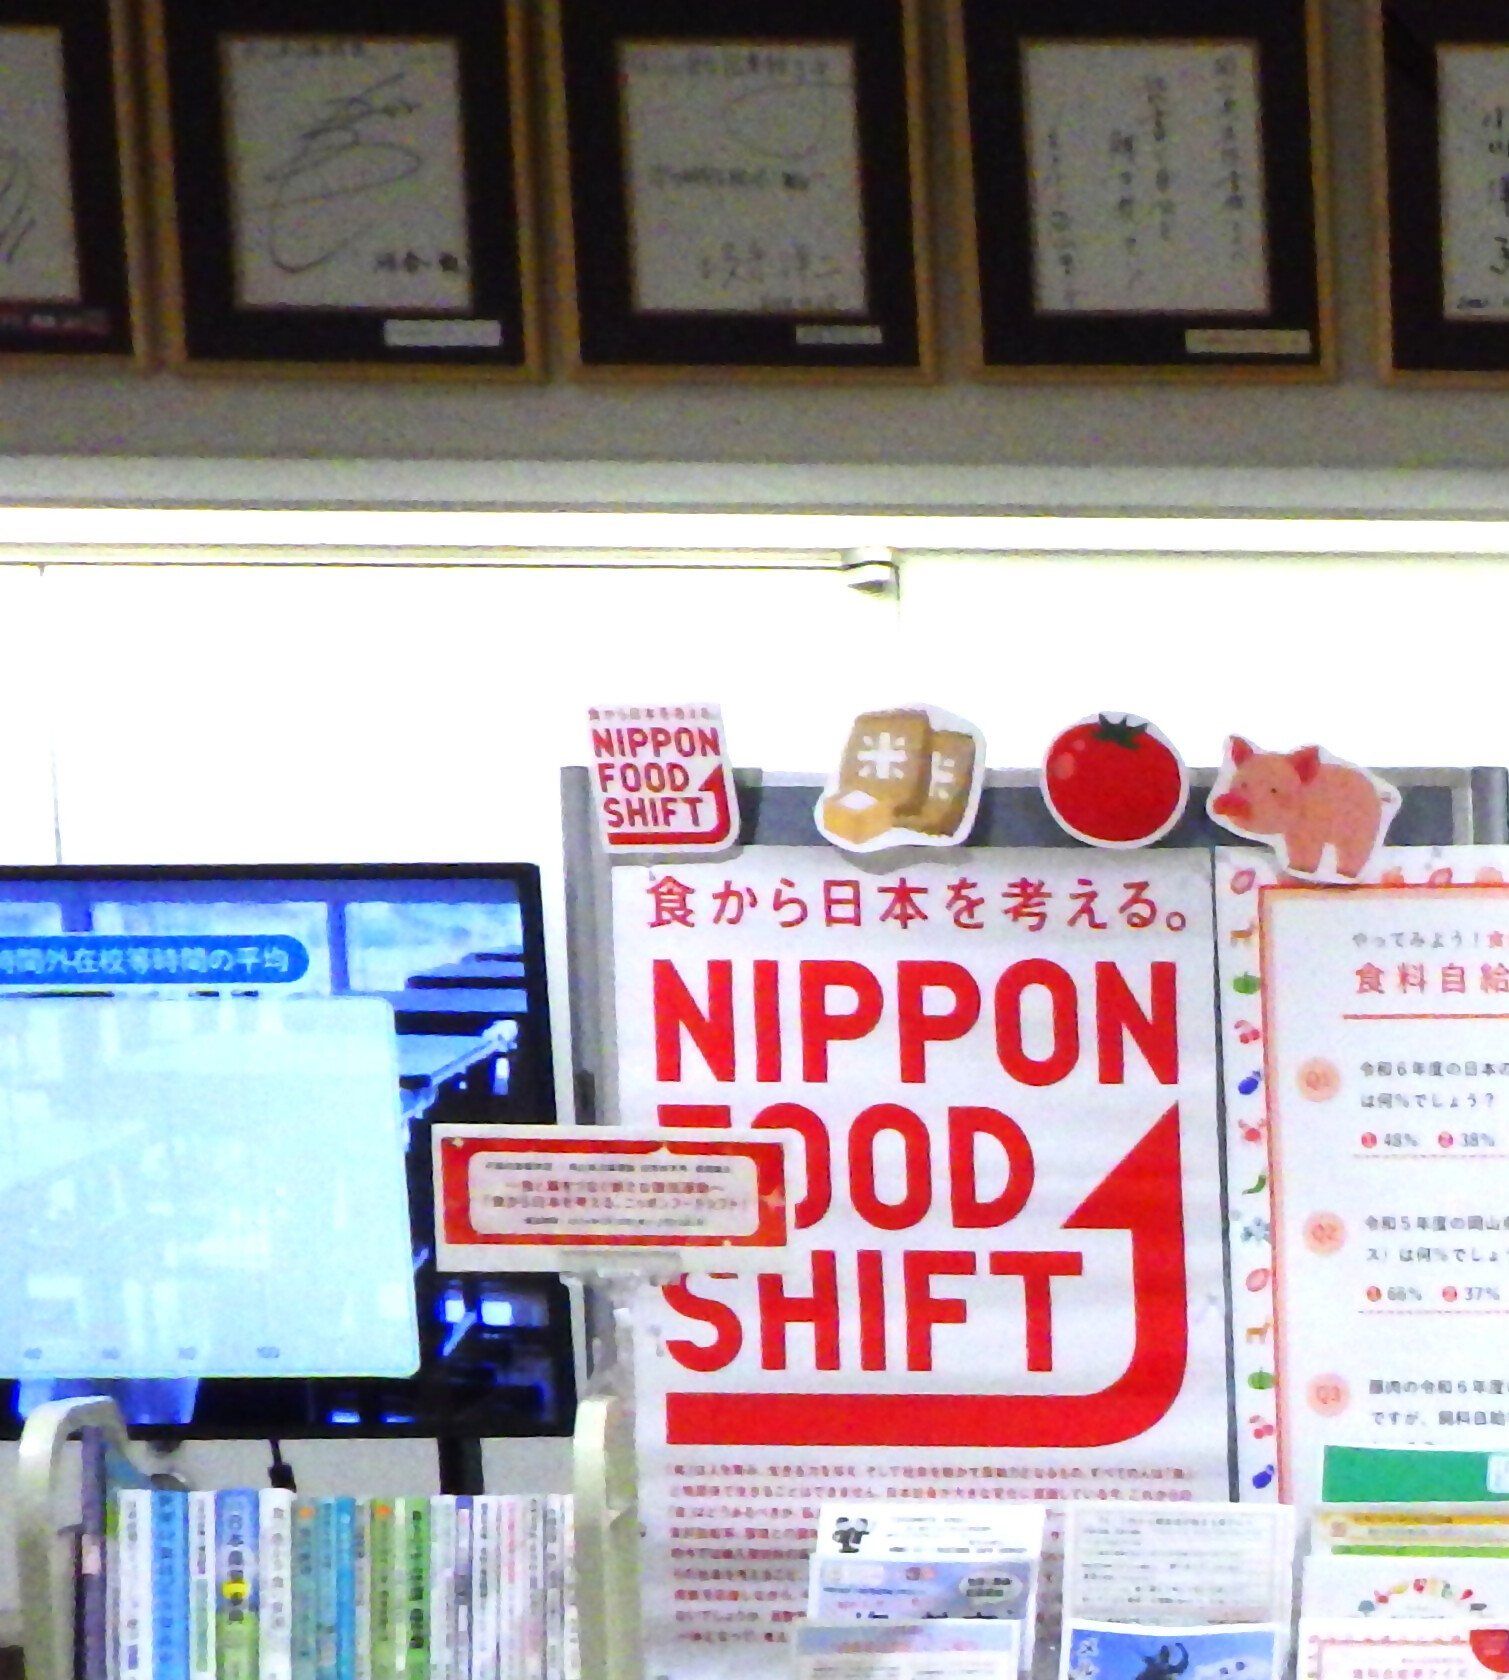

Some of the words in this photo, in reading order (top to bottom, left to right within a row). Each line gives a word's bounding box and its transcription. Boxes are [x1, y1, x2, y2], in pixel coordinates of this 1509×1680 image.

[592, 727, 721, 758] NIPPON
[598, 762, 690, 793] FOOD
[602, 796, 704, 829] SHIFT
[646, 873, 1188, 932] 食から日本を考える。
[652, 957, 1178, 1087] NIPPON
[656, 1101, 1035, 1231] OOD
[659, 1248, 1084, 1373] SHIFT
